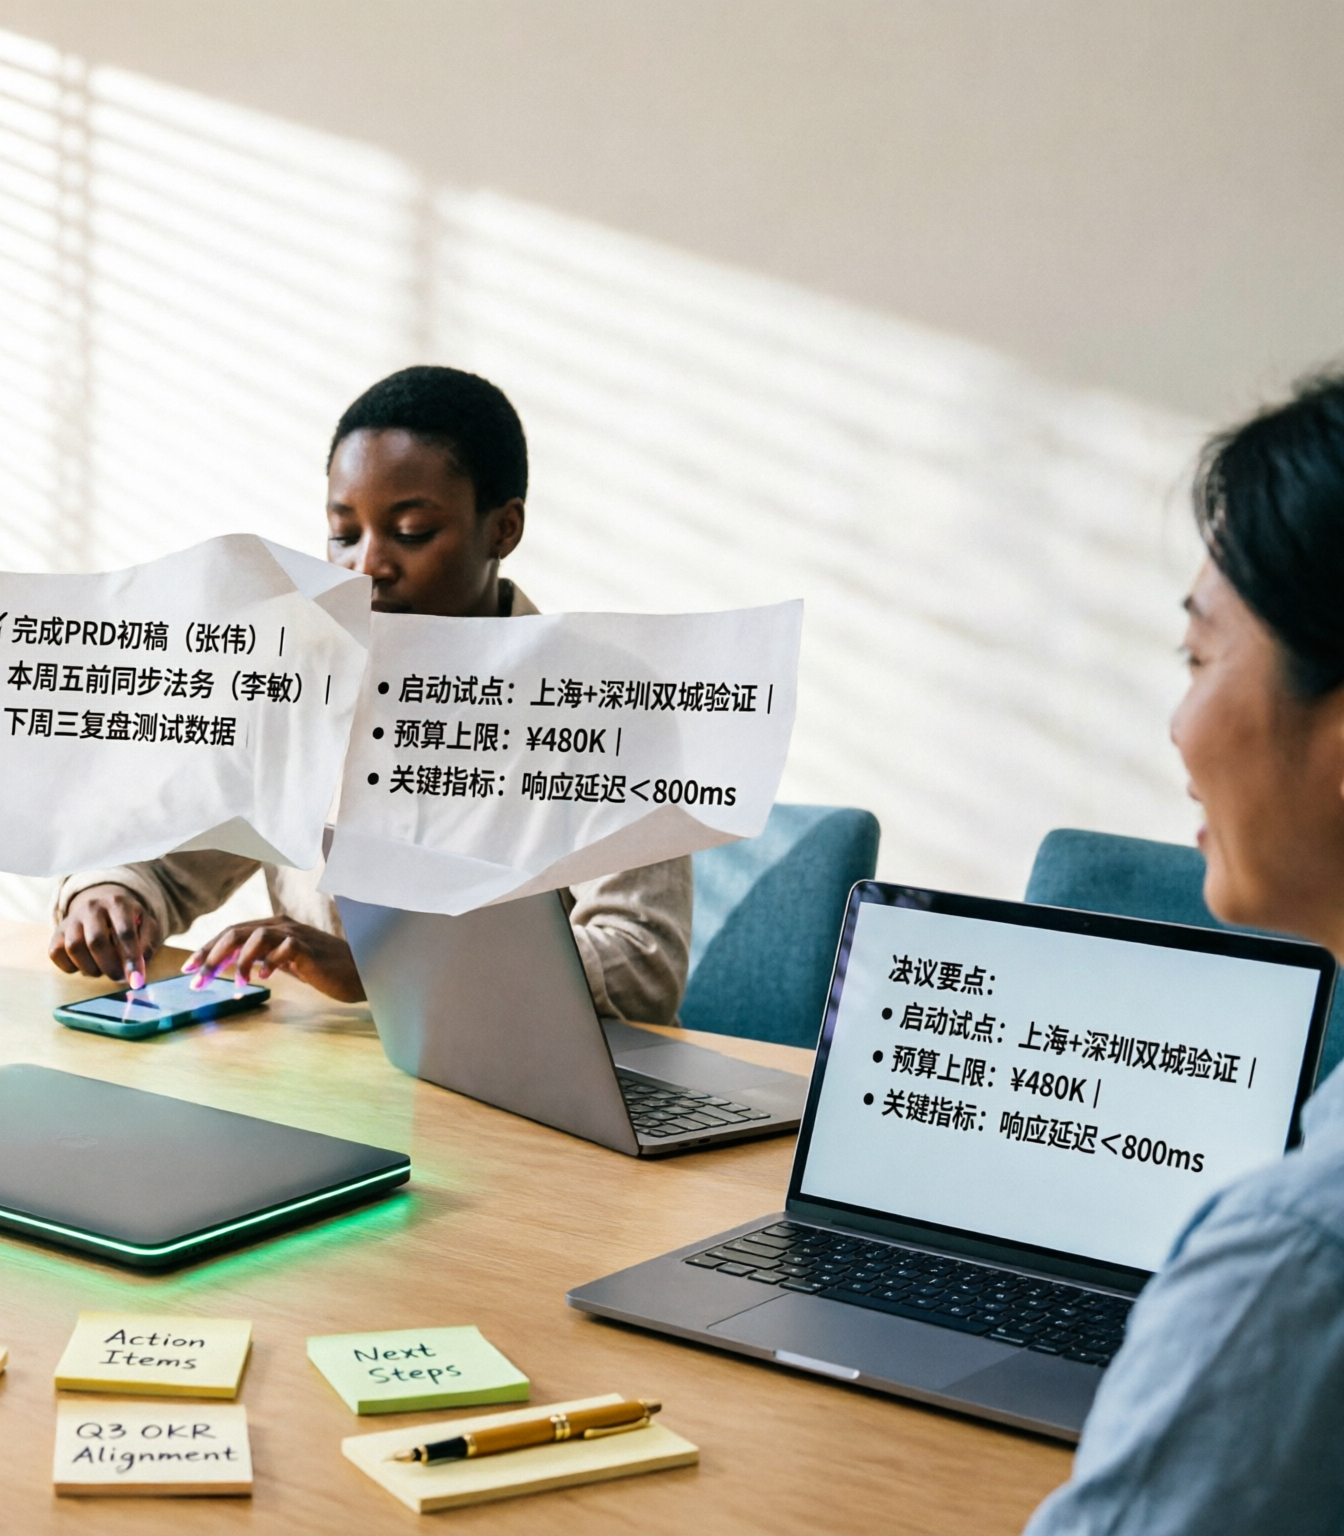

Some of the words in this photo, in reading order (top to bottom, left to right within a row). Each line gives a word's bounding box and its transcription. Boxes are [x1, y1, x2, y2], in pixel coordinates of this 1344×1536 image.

[4, 707, 236, 746] 下周三复盘测试数据
[104, 1328, 206, 1349] Action
[99, 1349, 198, 1371] Items
[353, 1342, 437, 1363] Next
[368, 1361, 462, 1385] Steps
[76, 1422, 127, 1441] Q3
[141, 1423, 217, 1440] OKR
[72, 1445, 238, 1475] Alignment
